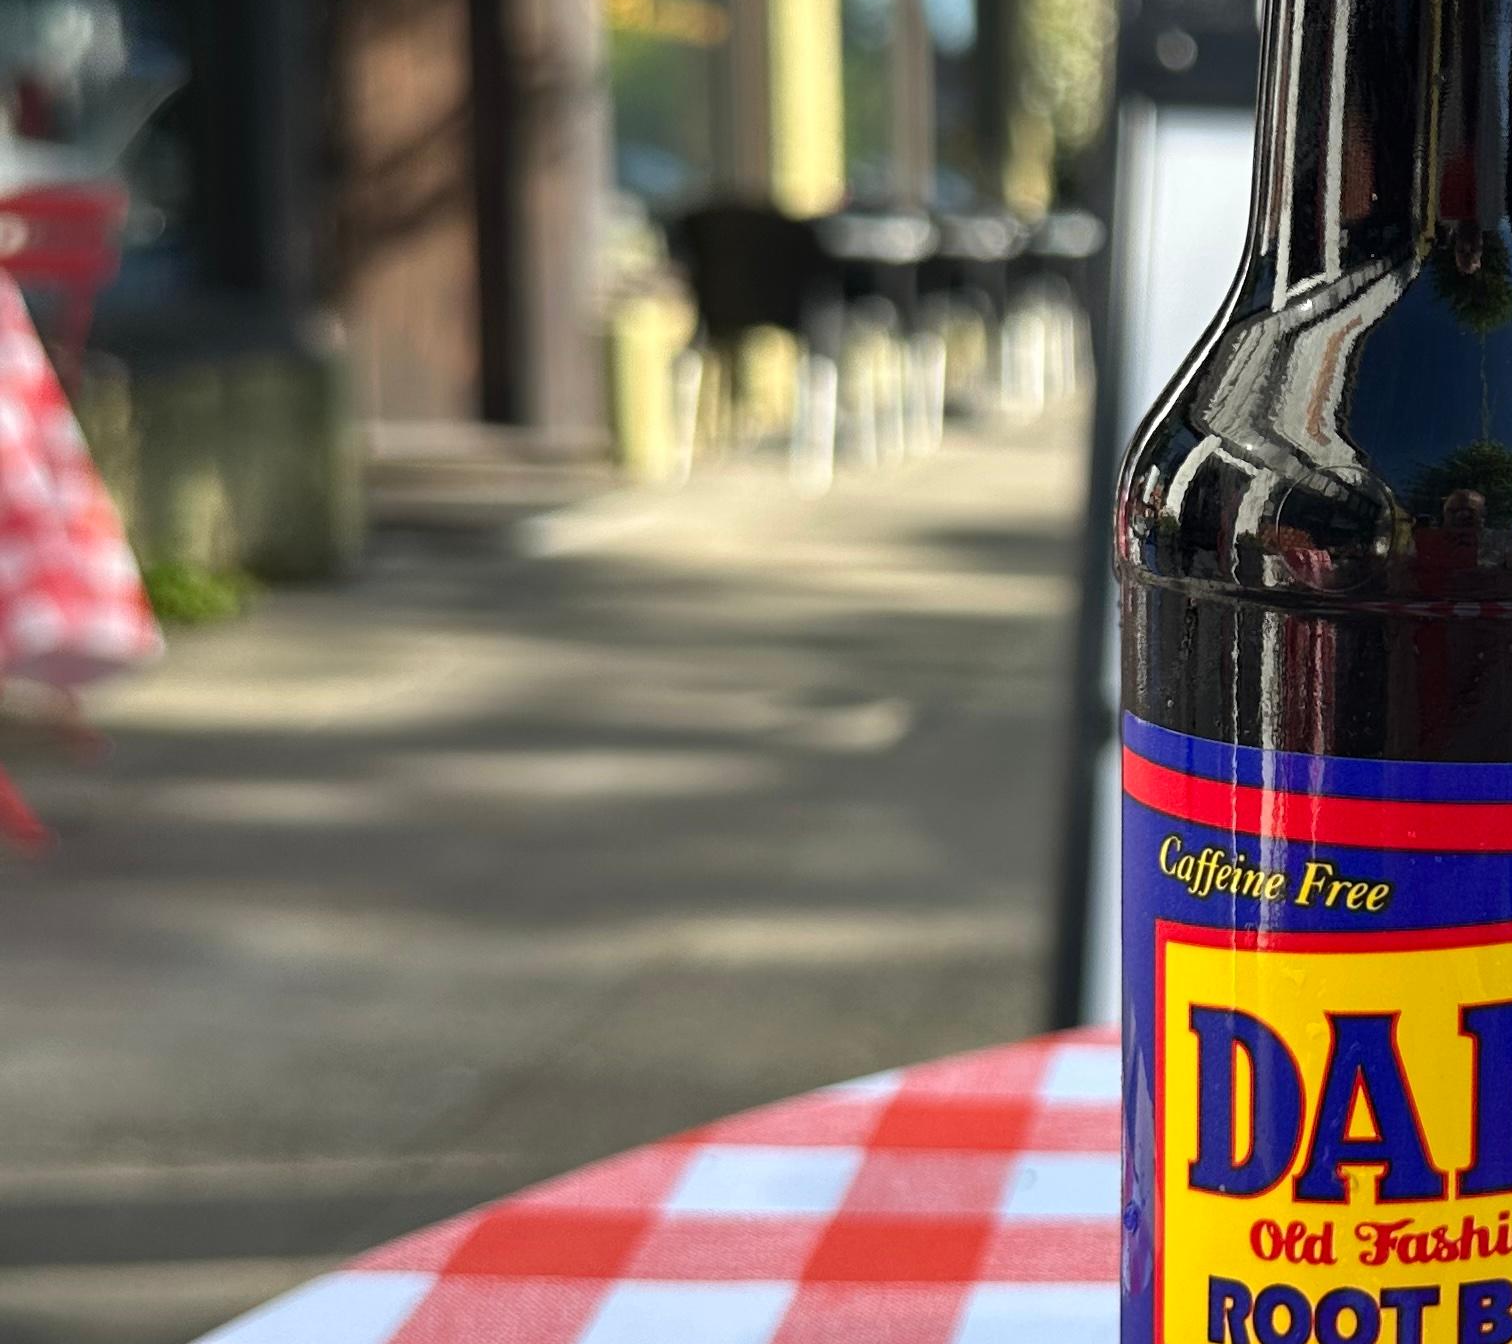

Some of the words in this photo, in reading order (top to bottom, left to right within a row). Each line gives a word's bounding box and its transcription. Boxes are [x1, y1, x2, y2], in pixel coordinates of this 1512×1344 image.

[1159, 835, 1286, 900] Caffeine
[1294, 861, 1391, 912] Free
[1249, 1218, 1338, 1267] Old
